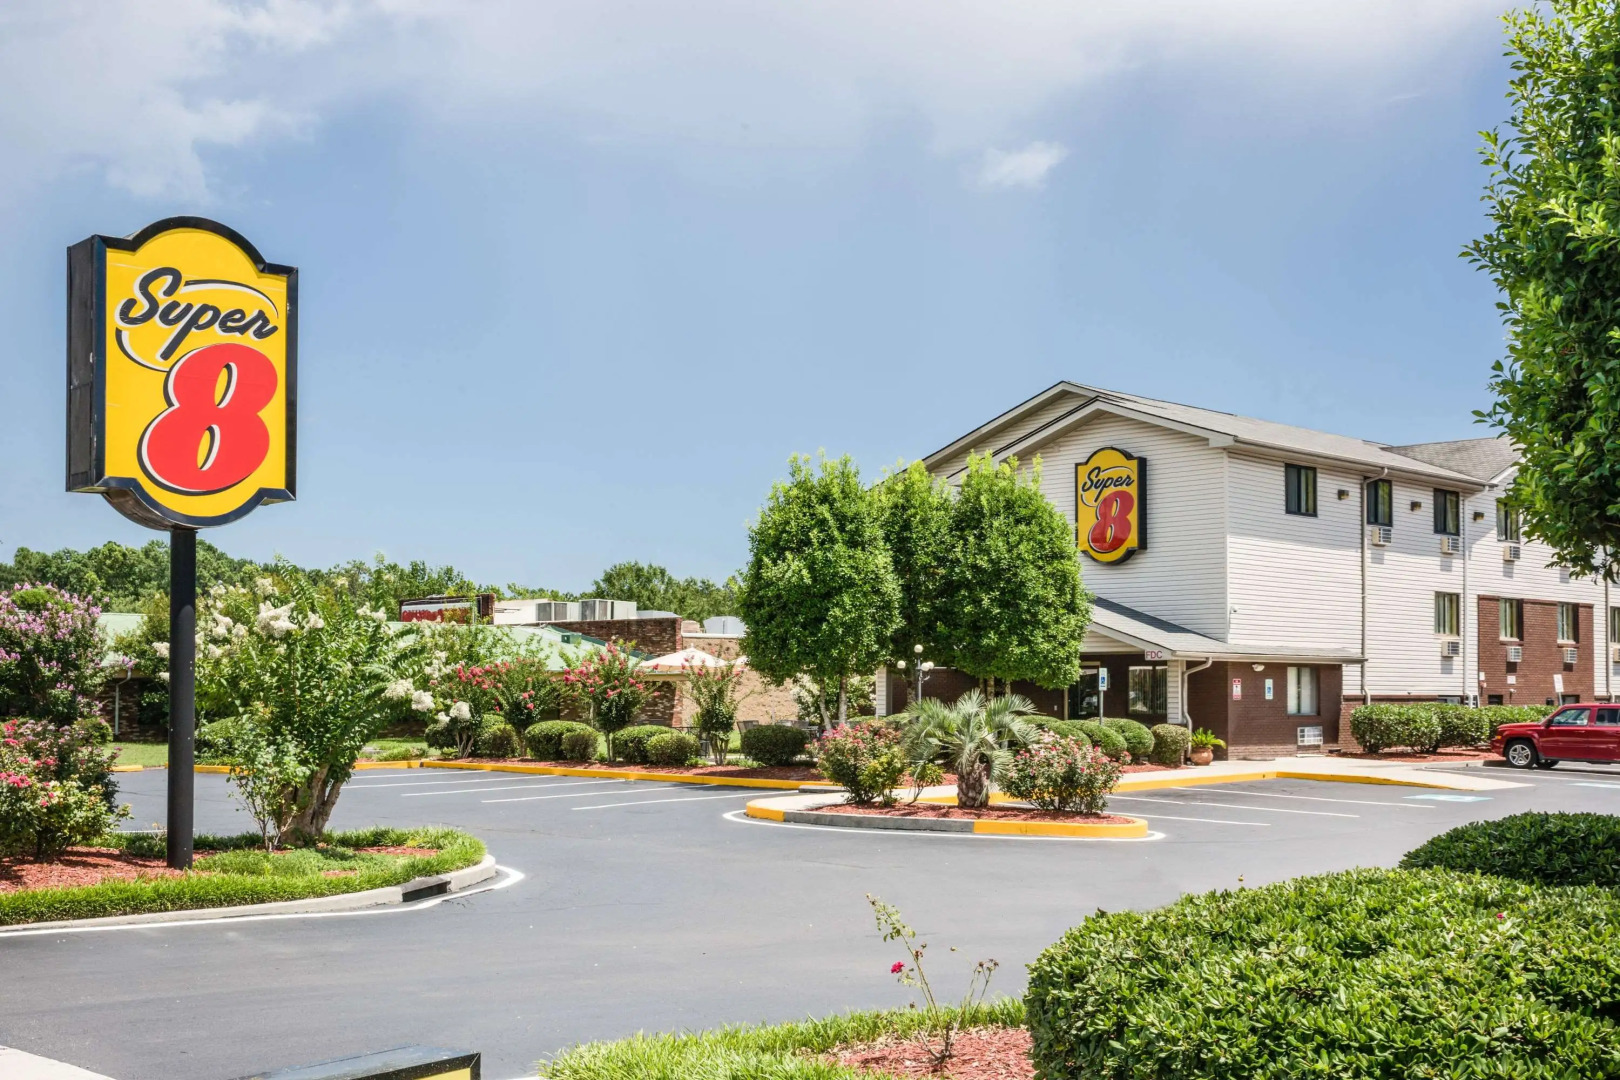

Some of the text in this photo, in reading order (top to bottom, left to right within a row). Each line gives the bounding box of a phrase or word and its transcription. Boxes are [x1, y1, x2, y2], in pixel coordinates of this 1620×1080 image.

[116, 266, 279, 361] Super
[136, 342, 278, 496] 8
[1082, 466, 1134, 502] Super
[1088, 490, 1134, 553] 8
[1145, 650, 1162, 659] FDC
